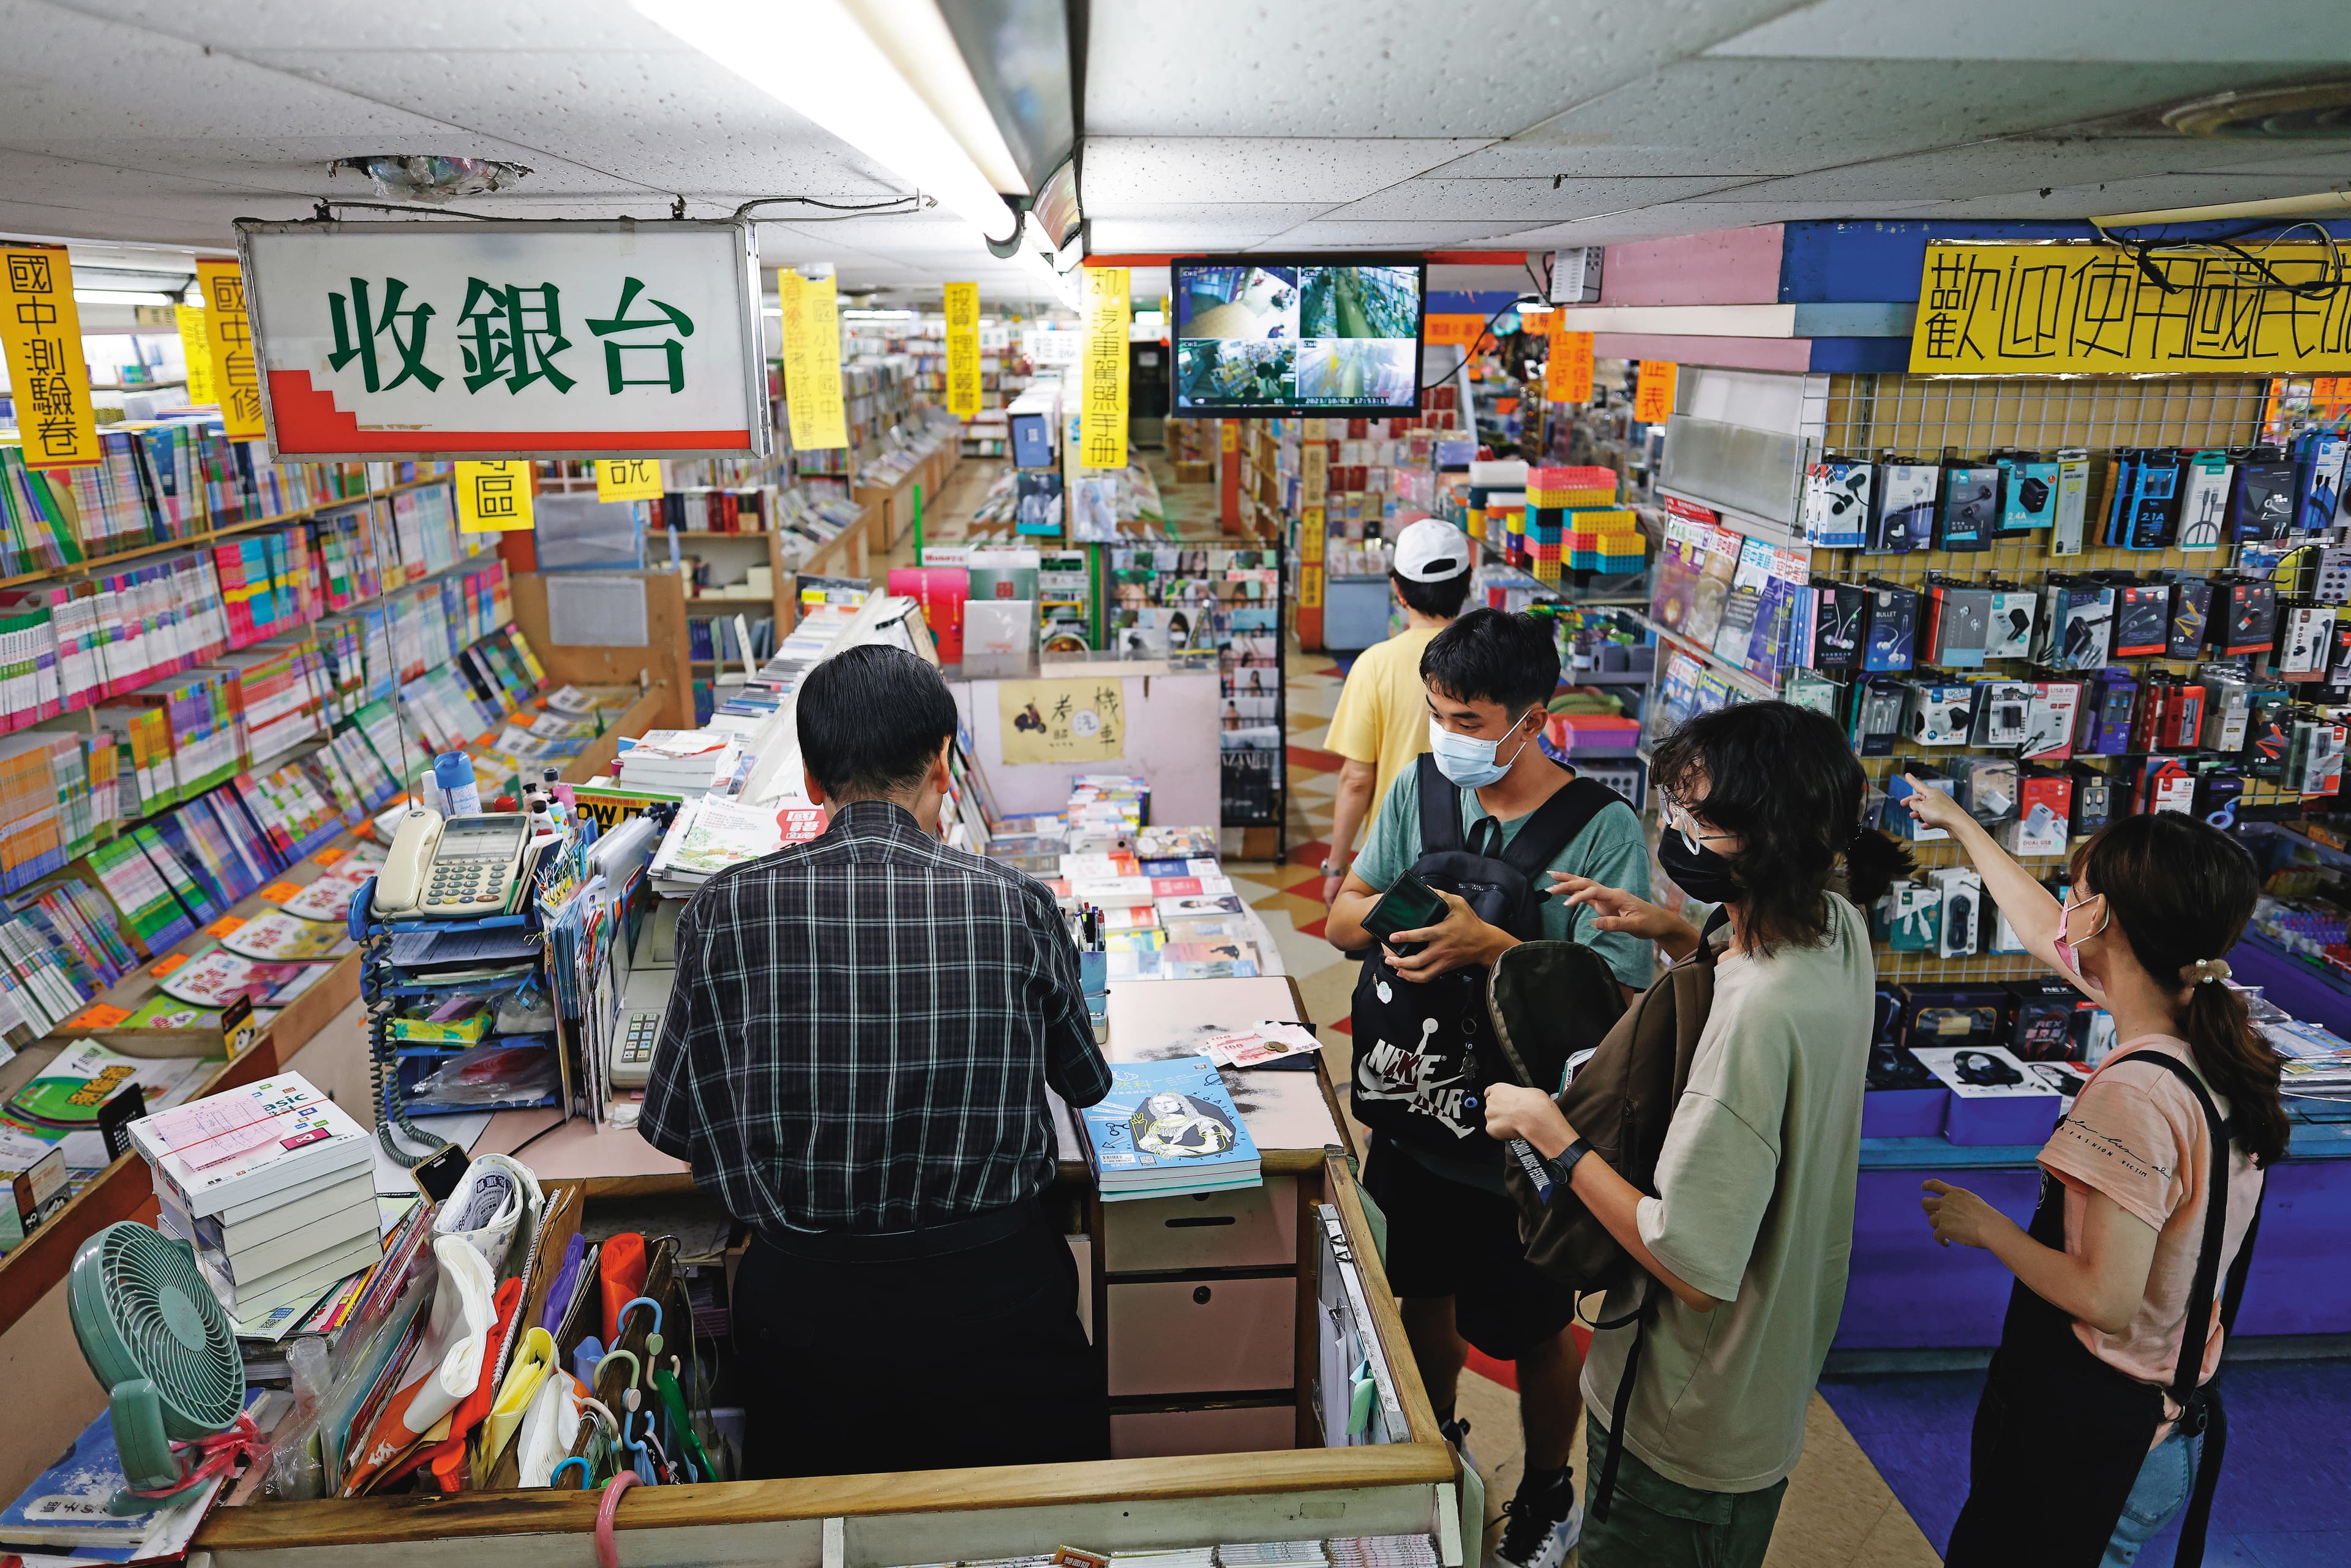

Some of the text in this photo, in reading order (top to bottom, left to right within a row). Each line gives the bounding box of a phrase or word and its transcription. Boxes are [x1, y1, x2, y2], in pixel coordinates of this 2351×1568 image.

[7, 254, 80, 457] 國中測驗卷
[213, 276, 264, 422] 國中自修
[328, 277, 694, 395] 收銀台
[475, 460, 518, 518] 區
[2008, 512, 2027, 520] 2.4A
[2140, 512, 2165, 522] 2.1A
[1076, 714, 1098, 733] 汽
[1094, 686, 1120, 752] 機車
[1368, 1038, 1441, 1084] NIKE
[263, 1093, 309, 1112] asic
[1408, 1089, 1465, 1119] AIR
[1510, 1138, 1552, 1192] SCHOOL MUSIC FESTIVAL
[2069, 1130, 2113, 1157] FASHION
[2121, 1160, 2148, 1177] VICTIM
[1063, 1556, 1091, 1568] 雙面版
